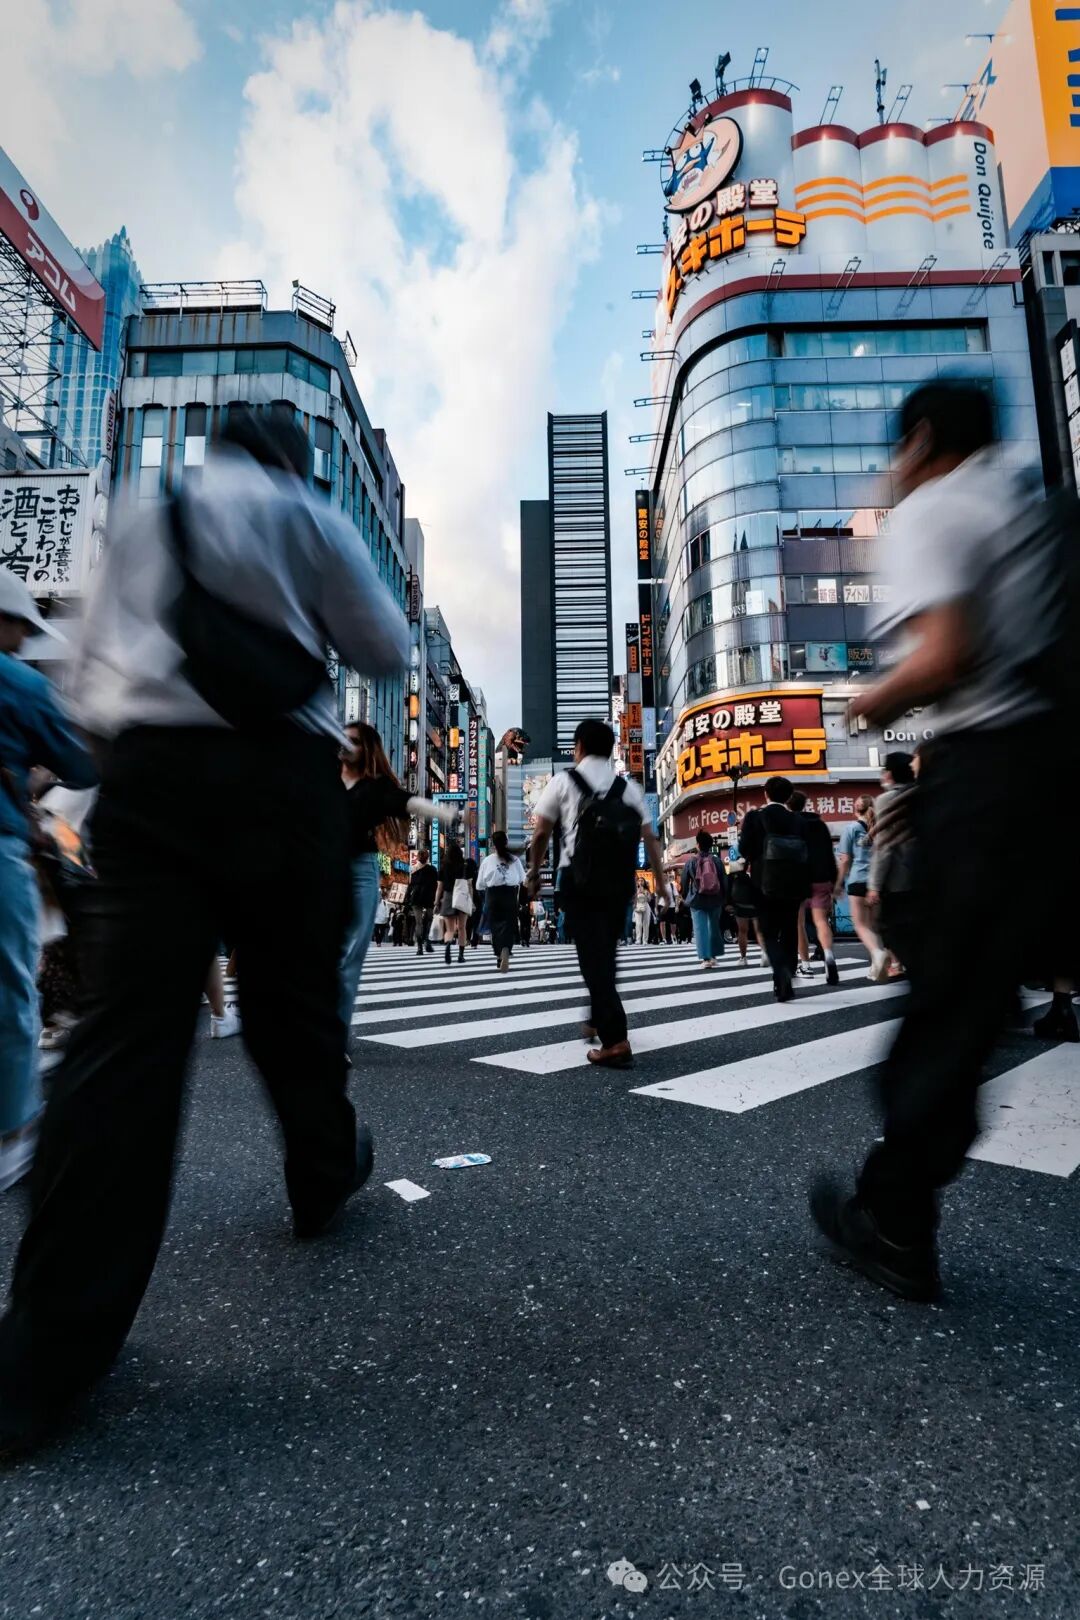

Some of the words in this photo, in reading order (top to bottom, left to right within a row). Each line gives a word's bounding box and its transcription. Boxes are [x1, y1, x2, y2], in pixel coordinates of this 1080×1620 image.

[971, 141, 988, 177] Don
[976, 184, 994, 250] Quijote
[26, 232, 76, 312] アコム
[0, 486, 41, 583] 酒と肴
[33, 496, 57, 582] こだわりの
[637, 508, 650, 560] 驚安の殿堂
[847, 648, 873, 660] 販売
[469, 720, 478, 786] カラオケ歌広場
[884, 729, 917, 742] Don
[688, 814, 700, 831] Tax
[701, 807, 729, 827] Free
